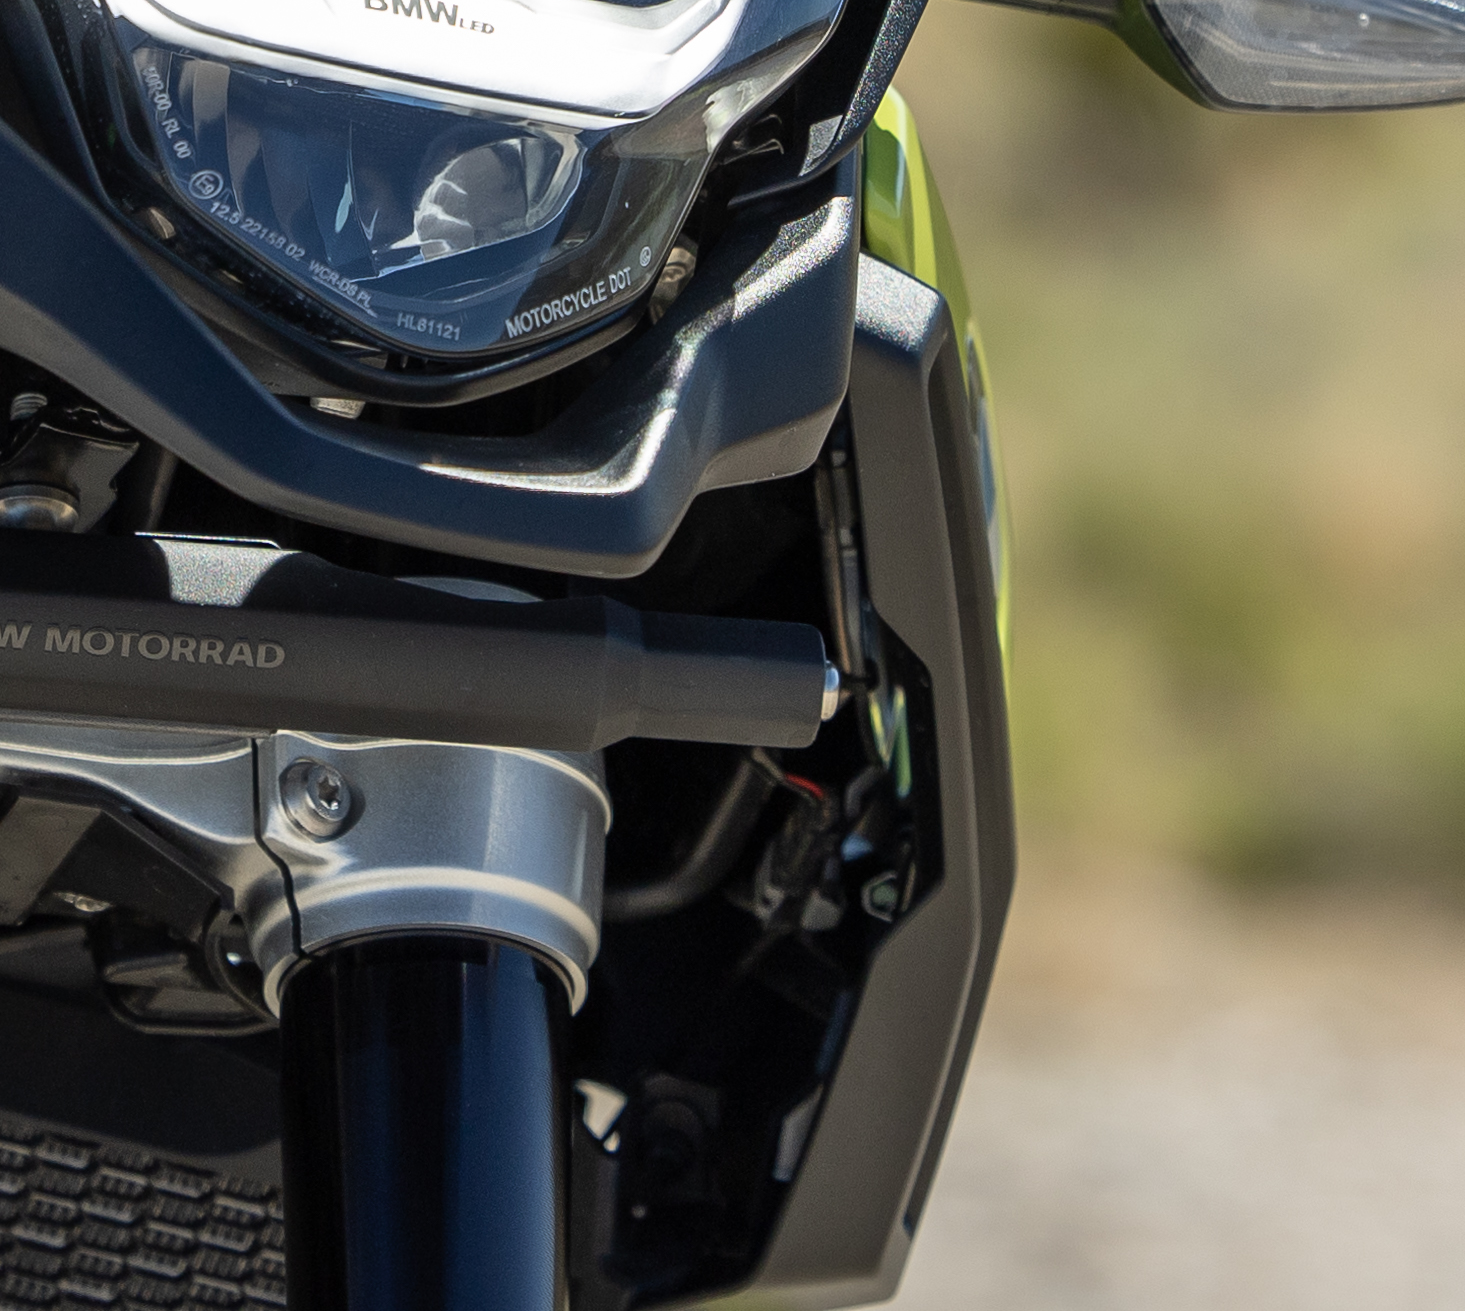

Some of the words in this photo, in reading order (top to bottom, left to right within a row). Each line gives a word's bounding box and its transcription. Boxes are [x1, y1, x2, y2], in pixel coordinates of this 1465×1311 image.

[161, 117, 181, 139] RL
[173, 139, 192, 160] 00
[209, 201, 241, 225] 12.5
[284, 242, 306, 262] 02
[356, 291, 372, 309] PL
[504, 280, 608, 339] MOTORCYCLE
[608, 266, 632, 294] DOT
[43, 623, 286, 669] MOTORRAD
